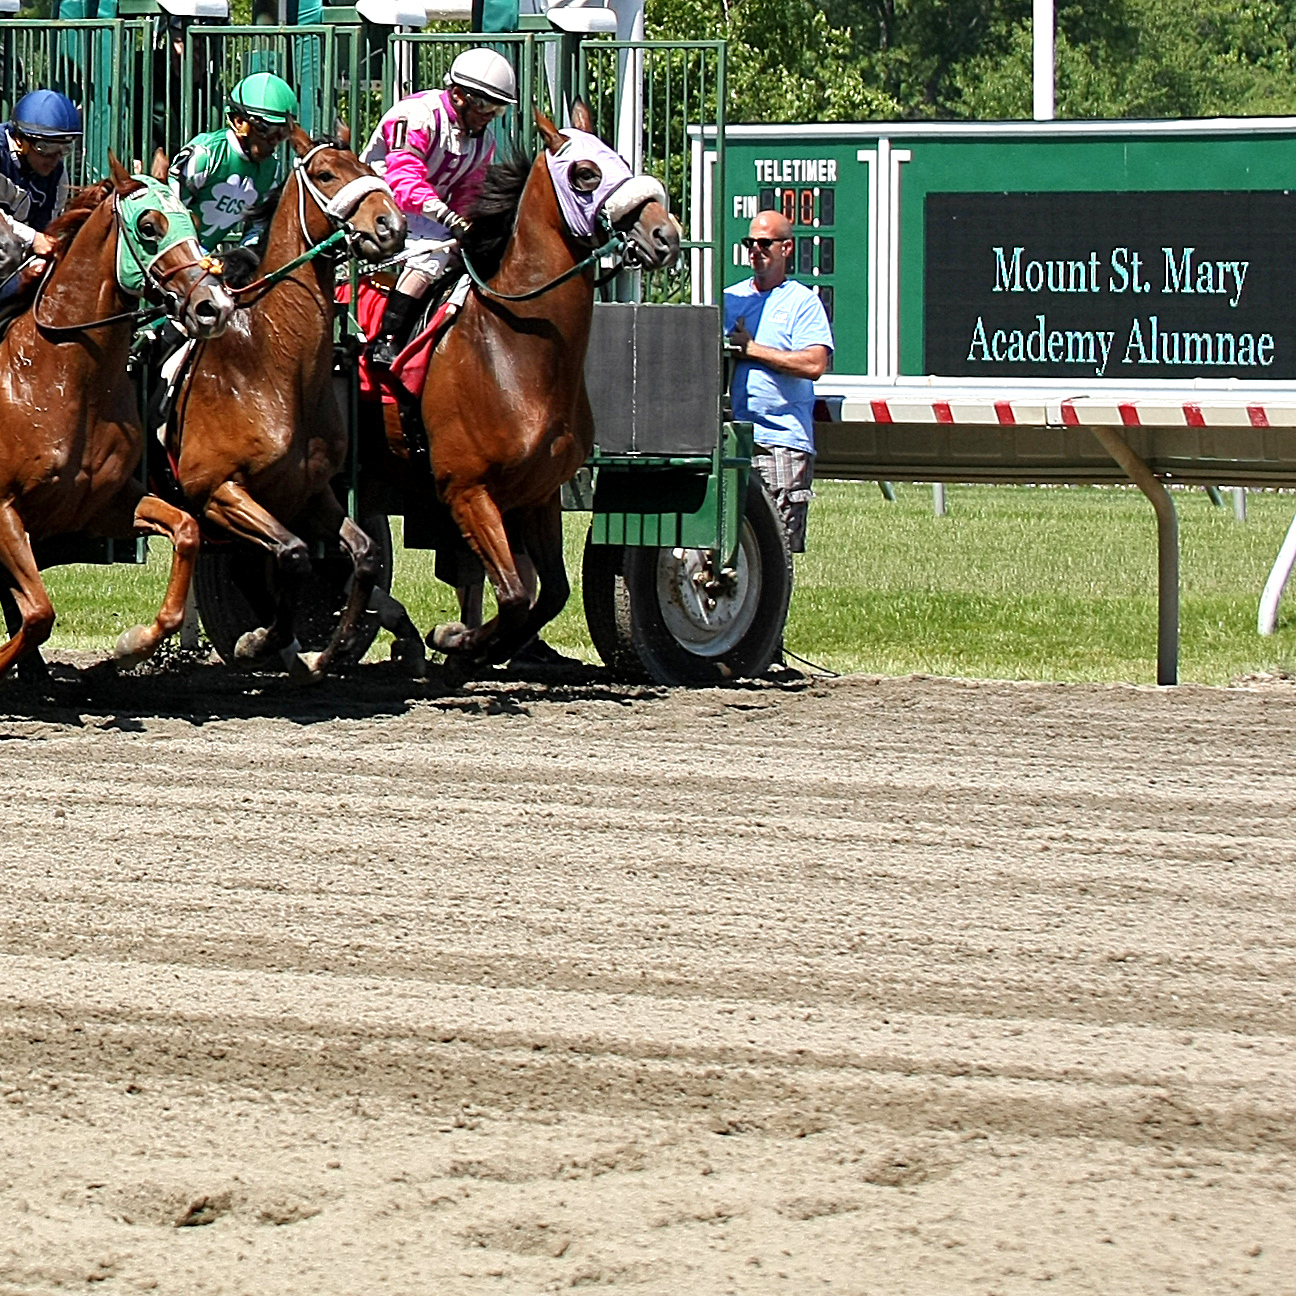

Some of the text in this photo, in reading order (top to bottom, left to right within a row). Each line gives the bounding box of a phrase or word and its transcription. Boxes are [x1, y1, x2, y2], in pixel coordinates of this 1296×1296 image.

[754, 159, 837, 182] TELETIMER
[215, 195, 245, 215] ECS
[733, 196, 758, 218] FIN
[992, 247, 1250, 307] Mount St. Mary
[967, 314, 1275, 376] Academy Alumnae
